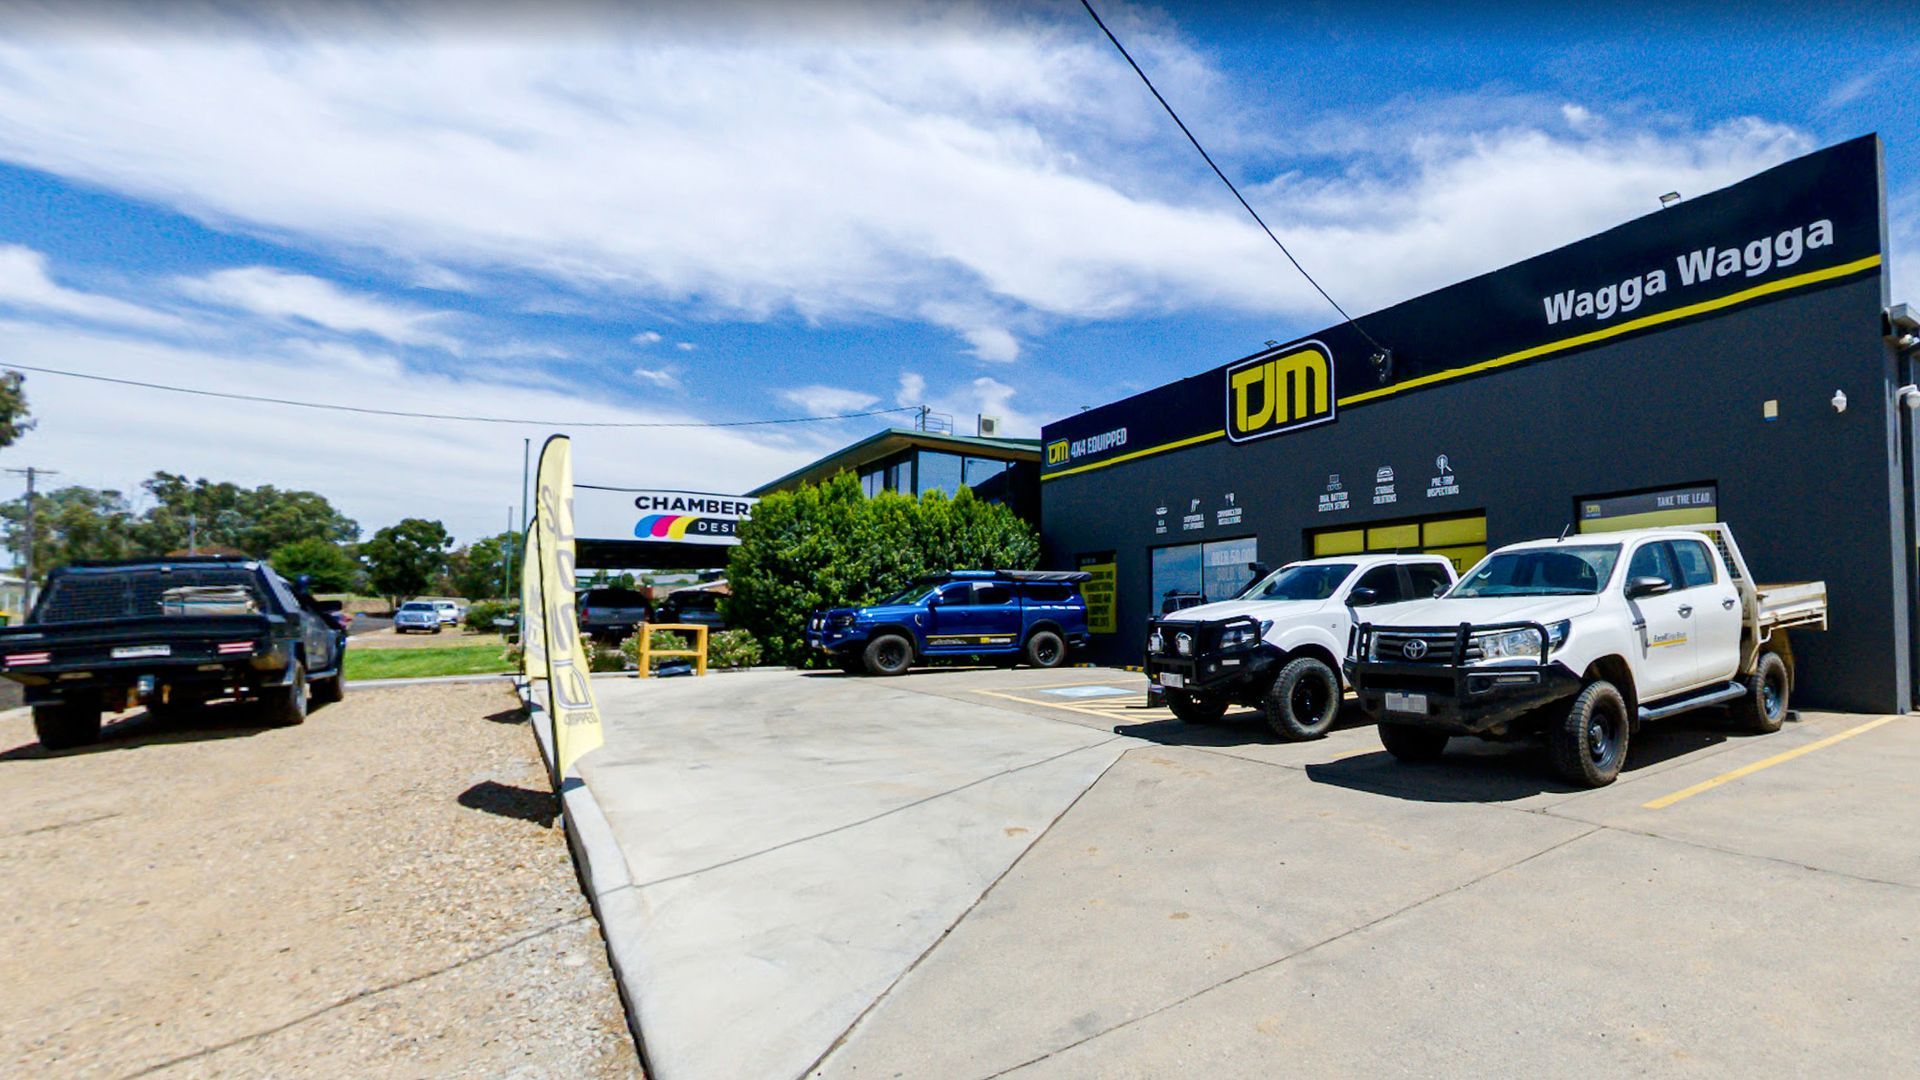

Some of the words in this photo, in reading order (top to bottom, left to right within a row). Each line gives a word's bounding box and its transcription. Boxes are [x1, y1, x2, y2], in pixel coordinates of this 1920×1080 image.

[1543, 269, 1666, 325] Wagga
[1676, 218, 1834, 287] Wagga
[1232, 349, 1328, 433] TJM
[1087, 427, 1128, 454] EQUIPPED
[634, 496, 753, 515] CHAMBER
[1657, 495, 1675, 507] TAKE
[1676, 494, 1690, 504] THE
